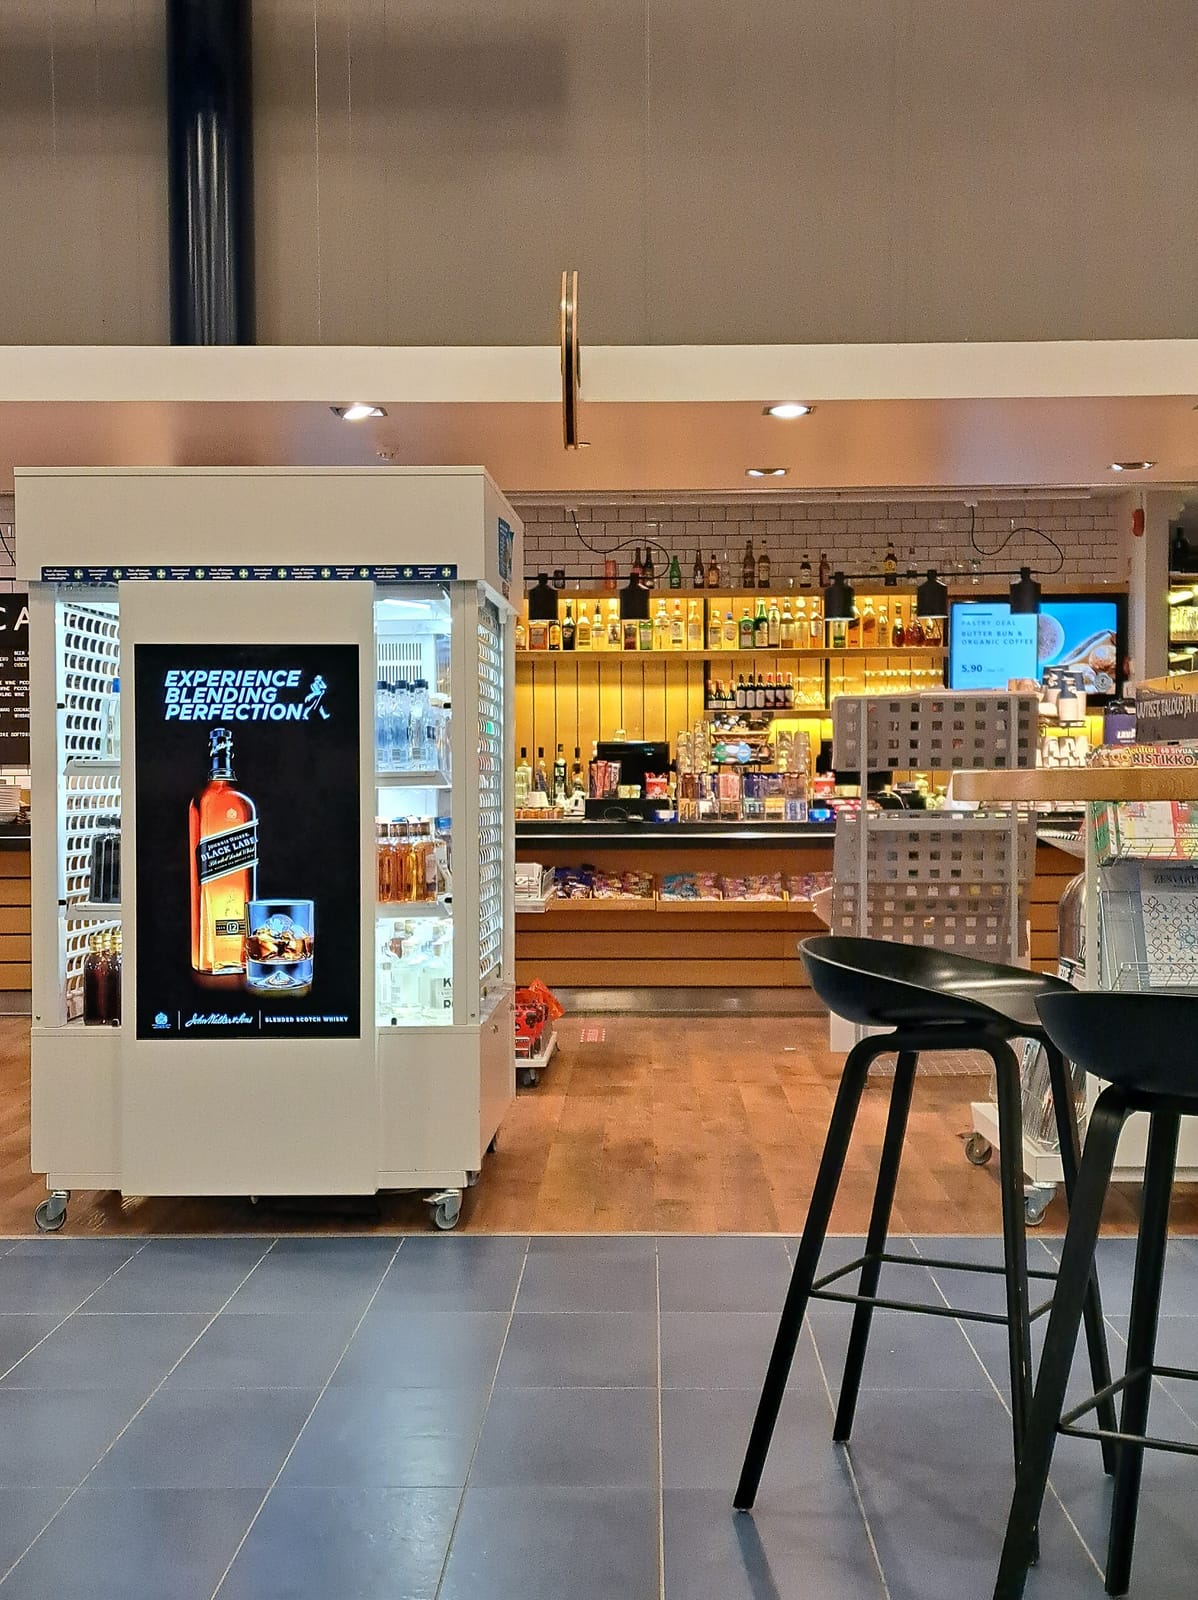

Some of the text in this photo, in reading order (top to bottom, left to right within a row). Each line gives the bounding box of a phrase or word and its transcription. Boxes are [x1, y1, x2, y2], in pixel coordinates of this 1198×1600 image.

[961, 664, 983, 673] 5.90
[164, 670, 301, 687] EXPERIENCE
[165, 687, 277, 704] BLENDING
[1161, 696, 1184, 716] TALOUS
[1132, 753, 1194, 766] RISTIKKO
[200, 845, 232, 862] BLACK
